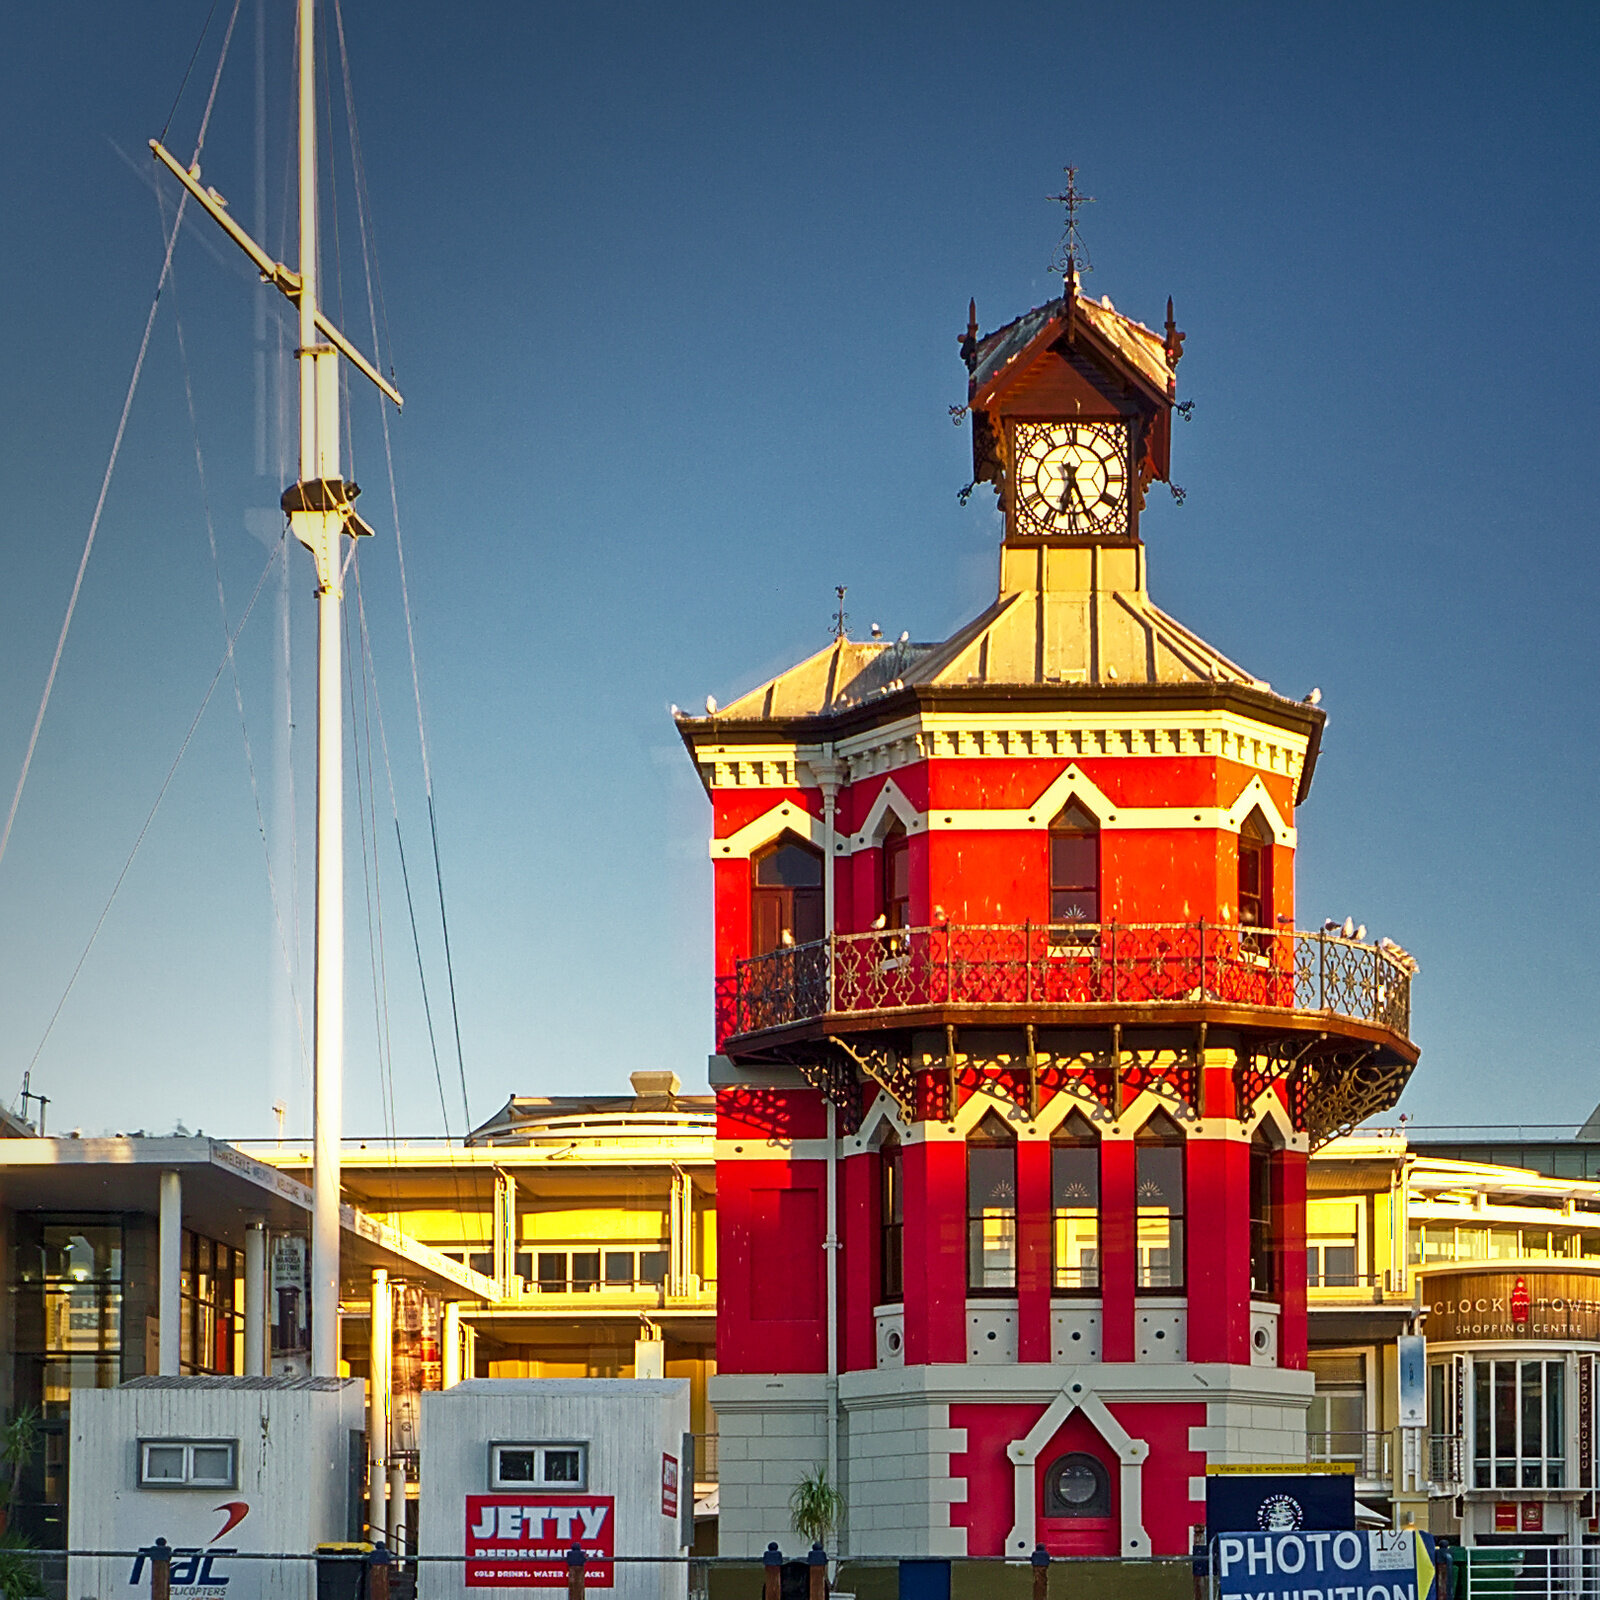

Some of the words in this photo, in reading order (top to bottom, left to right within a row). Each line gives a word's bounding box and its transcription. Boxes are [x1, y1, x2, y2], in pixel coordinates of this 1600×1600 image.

[1433, 1298, 1505, 1316] CLOCK
[1455, 1323, 1525, 1336] SHOPPING
[1533, 1323, 1582, 1335] CENTRE
[471, 1505, 609, 1540] JETTY
[1219, 1531, 1363, 1577] PHOTO
[474, 1570, 495, 1578] COLD
[534, 1570, 564, 1578] WATER
[584, 1570, 605, 1578] ACKS
[169, 1586, 227, 1596] ELICOPTERS
